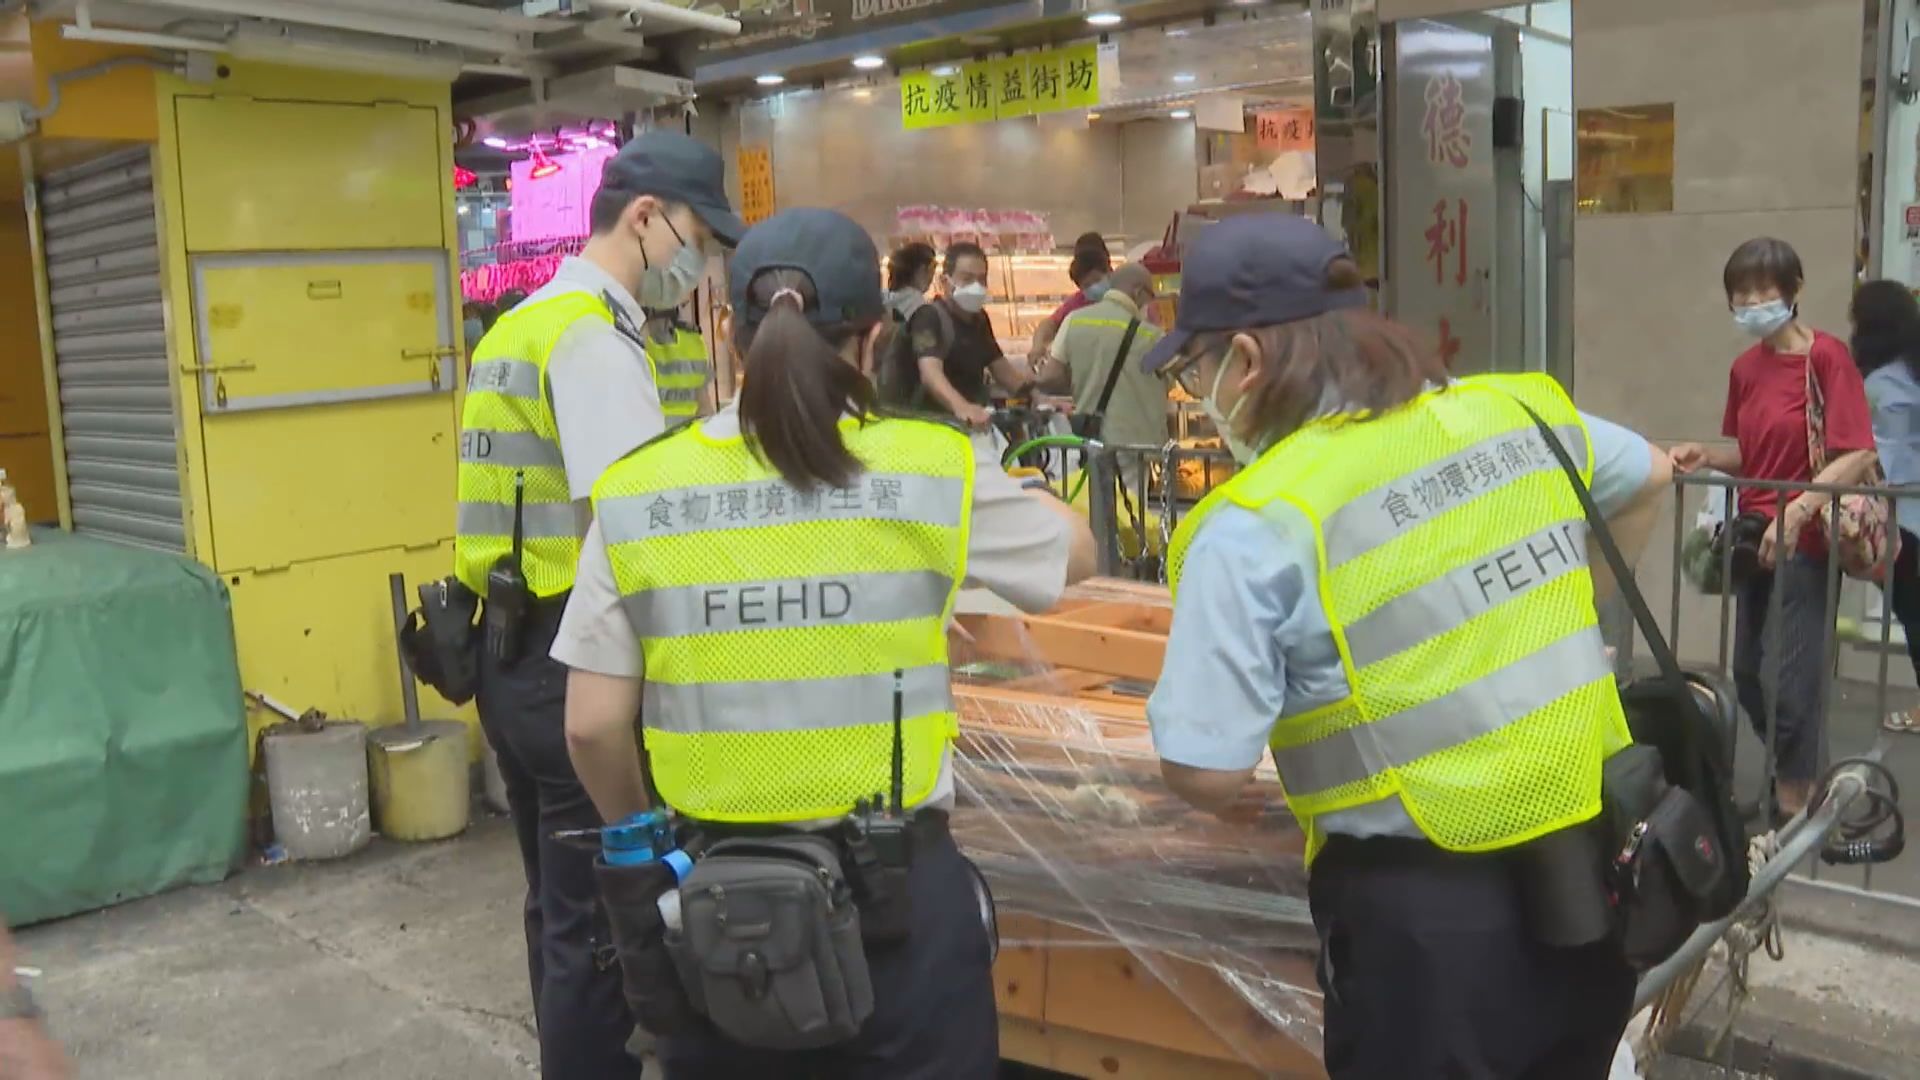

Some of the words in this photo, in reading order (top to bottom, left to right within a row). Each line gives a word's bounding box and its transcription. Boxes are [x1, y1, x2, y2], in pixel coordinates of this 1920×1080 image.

[905, 59, 1093, 115] 抗疫情益街坊
[703, 580, 852, 627] FEHD
